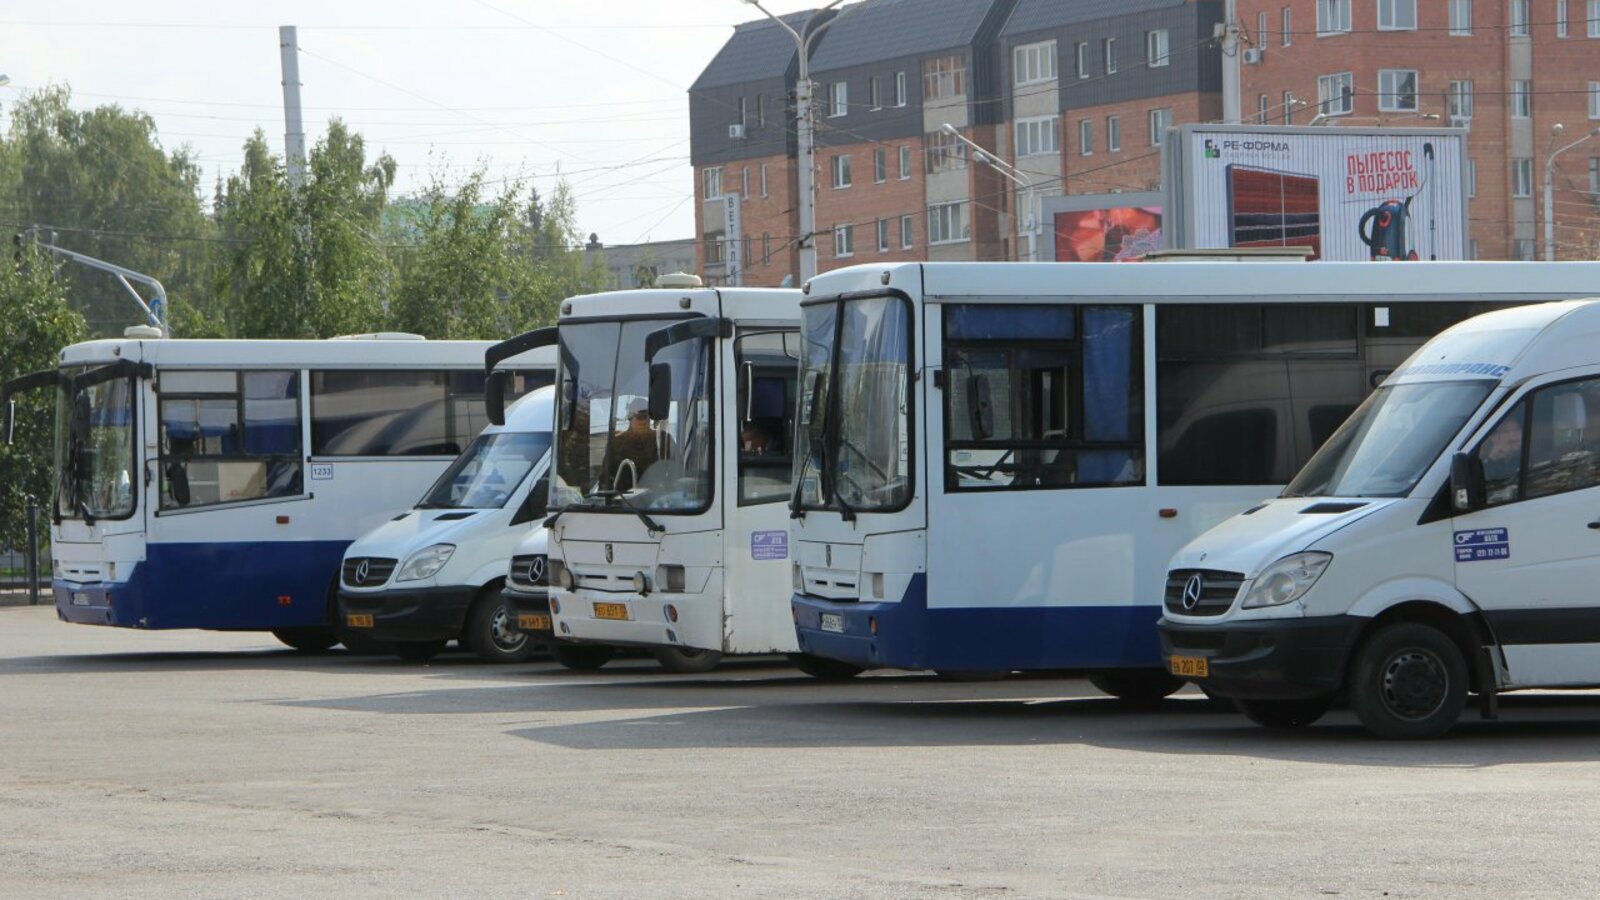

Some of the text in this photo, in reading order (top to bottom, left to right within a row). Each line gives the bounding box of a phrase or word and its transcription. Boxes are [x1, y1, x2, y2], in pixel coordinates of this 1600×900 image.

[1223, 140, 1289, 152] РЕ-ФОРМА
[1347, 150, 1413, 176] ПЫЛЕСОС
[1346, 171, 1418, 194] В ПОДАРОК
